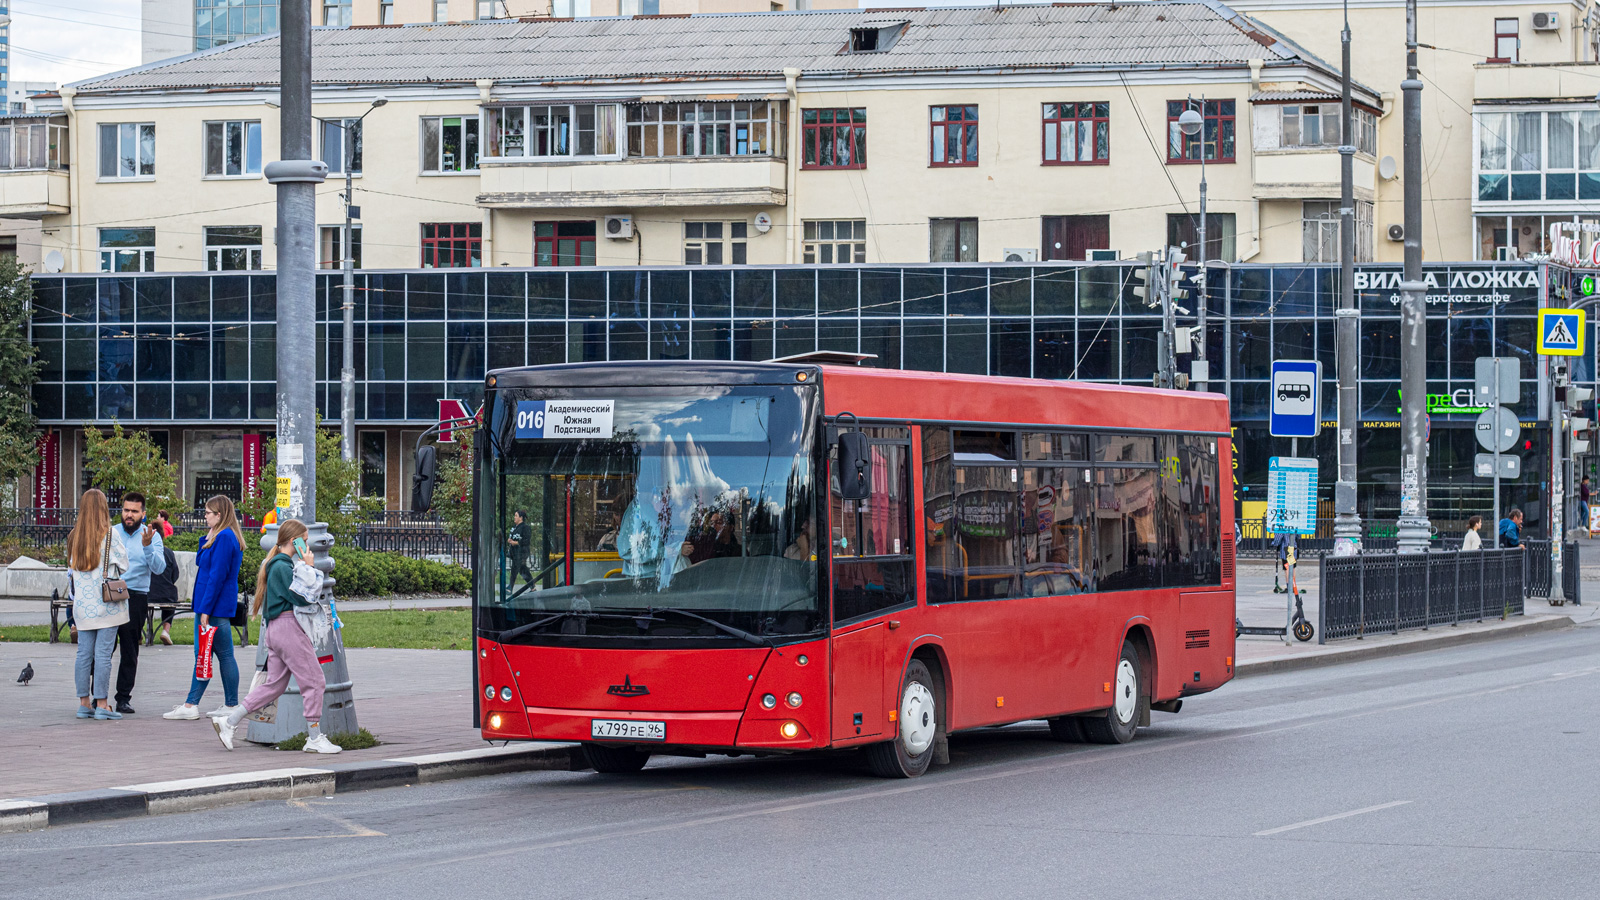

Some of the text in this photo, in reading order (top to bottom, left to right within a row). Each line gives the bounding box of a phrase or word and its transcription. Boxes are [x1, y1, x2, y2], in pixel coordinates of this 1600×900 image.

[1354, 271, 1541, 289] ВИЛА ЛОЖКА
[1477, 293, 1511, 306] кафе
[548, 404, 610, 414] Академический
[517, 410, 544, 429] 016
[563, 415, 592, 424] Южная
[553, 424, 600, 434] Подстанция
